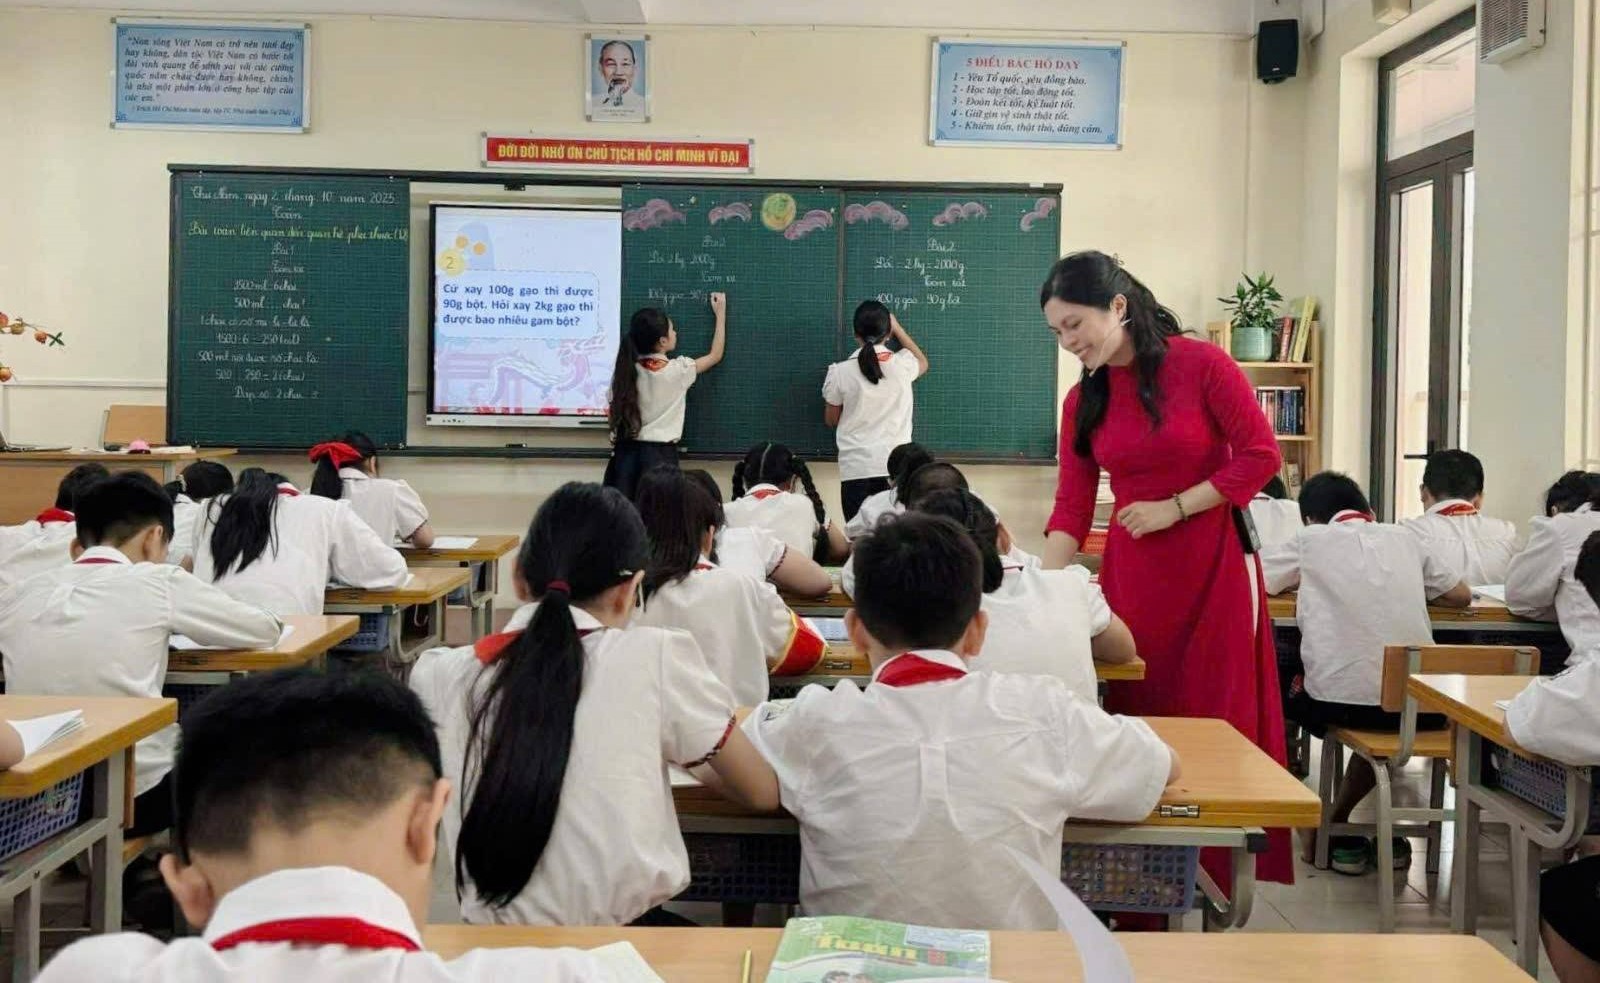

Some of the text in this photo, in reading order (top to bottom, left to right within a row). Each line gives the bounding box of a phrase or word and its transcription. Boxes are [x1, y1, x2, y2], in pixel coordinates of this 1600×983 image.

[195, 39, 212, 47] Nam
[125, 49, 139, 58] hay
[967, 58, 972, 67] 5
[953, 72, 958, 81] 1
[952, 85, 958, 93] 2
[952, 97, 957, 105] 3
[499, 142, 739, 166] ĐỜI ĐỜI NHỚ ƠN CHỦ TỊCH HỒ CHÍ MINH VĨ ĐẠI
[370, 193, 395, 204] 2025
[446, 256, 455, 270] 2
[443, 283, 593, 297] Cứ xay 100g gạo thì được
[443, 300, 462, 311] 90g
[491, 301, 510, 310] Hỏi
[513, 303, 531, 313] xay
[535, 301, 553, 312] 2kg
[557, 303, 575, 313] gạo
[579, 301, 593, 311] thì
[443, 315, 580, 327] được bao nhiêu gam bột?
